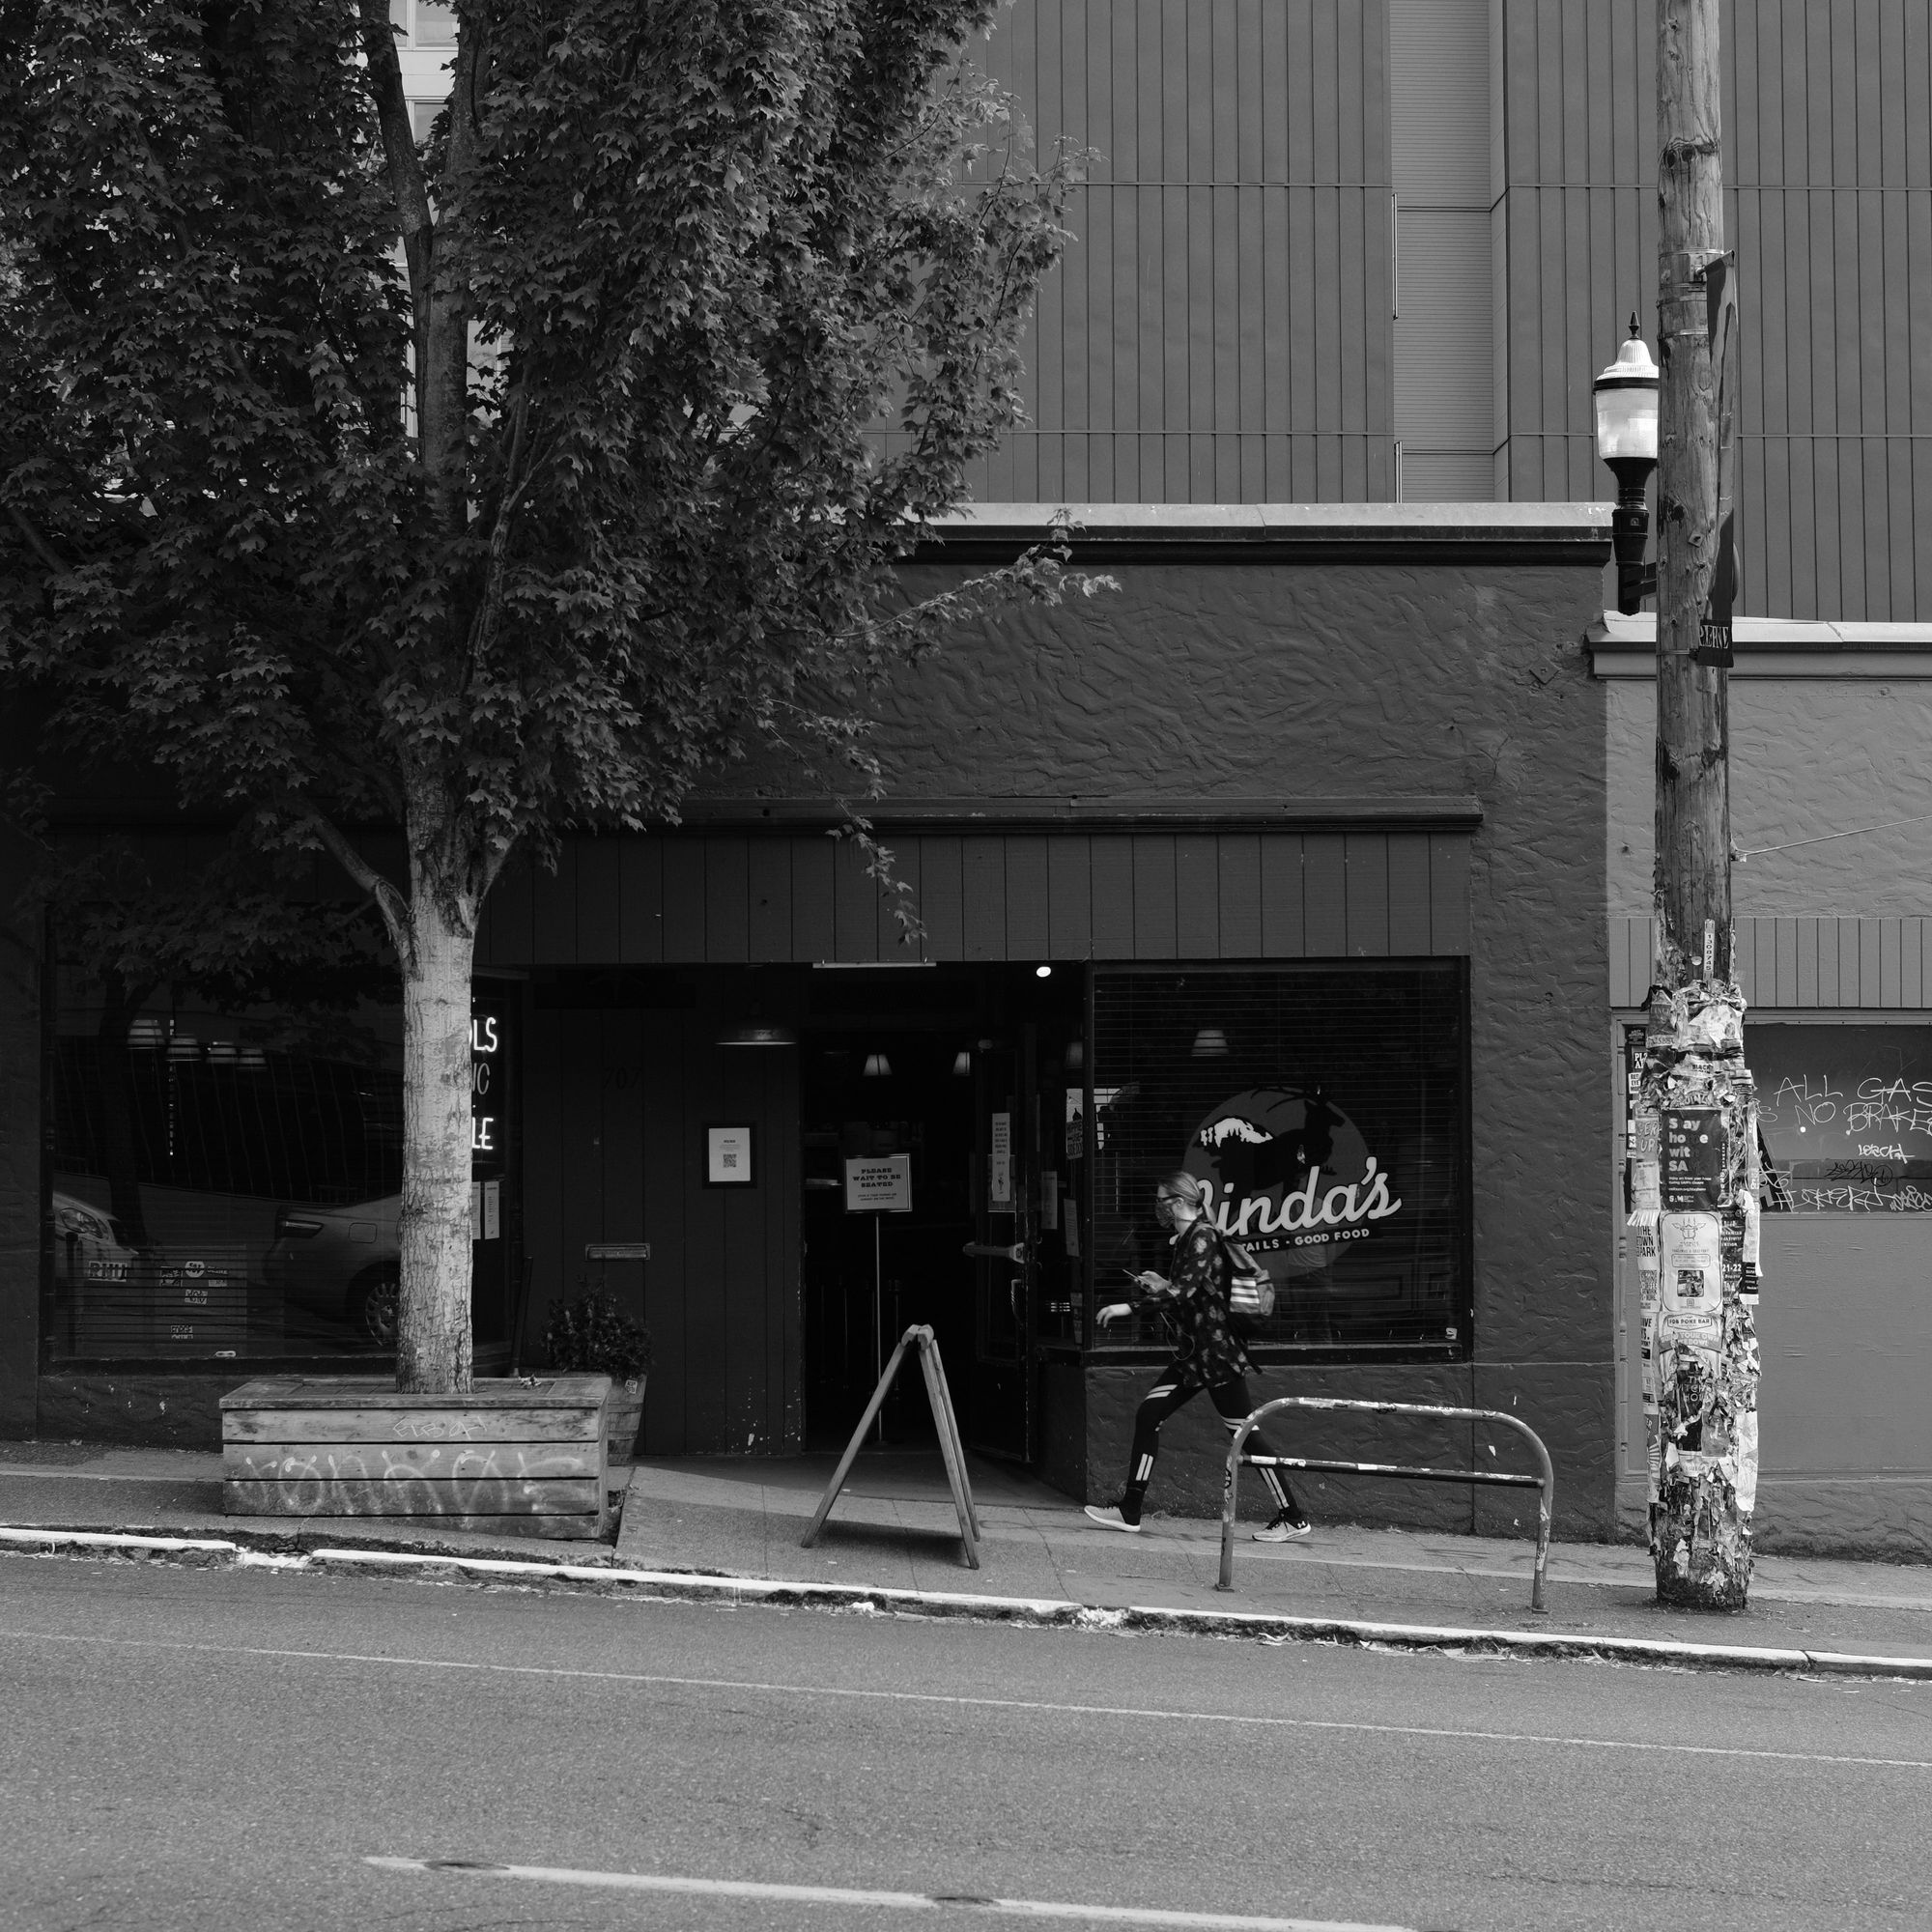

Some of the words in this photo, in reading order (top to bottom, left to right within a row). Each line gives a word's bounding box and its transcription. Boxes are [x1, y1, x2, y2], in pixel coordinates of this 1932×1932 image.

[469, 1016, 497, 1053] LS
[603, 1065, 642, 1091] 707
[1773, 1073, 1844, 1107] ALL
[1857, 1077, 1932, 1108] GAS
[1794, 1101, 1836, 1125] NO
[1668, 1118, 1701, 1131] Say
[1668, 1131, 1709, 1144] hoe
[1668, 1145, 1695, 1157] wit
[1668, 1160, 1691, 1172] SA
[1294, 1233, 1330, 1246] GOOD
[1334, 1228, 1371, 1241] FOOD
